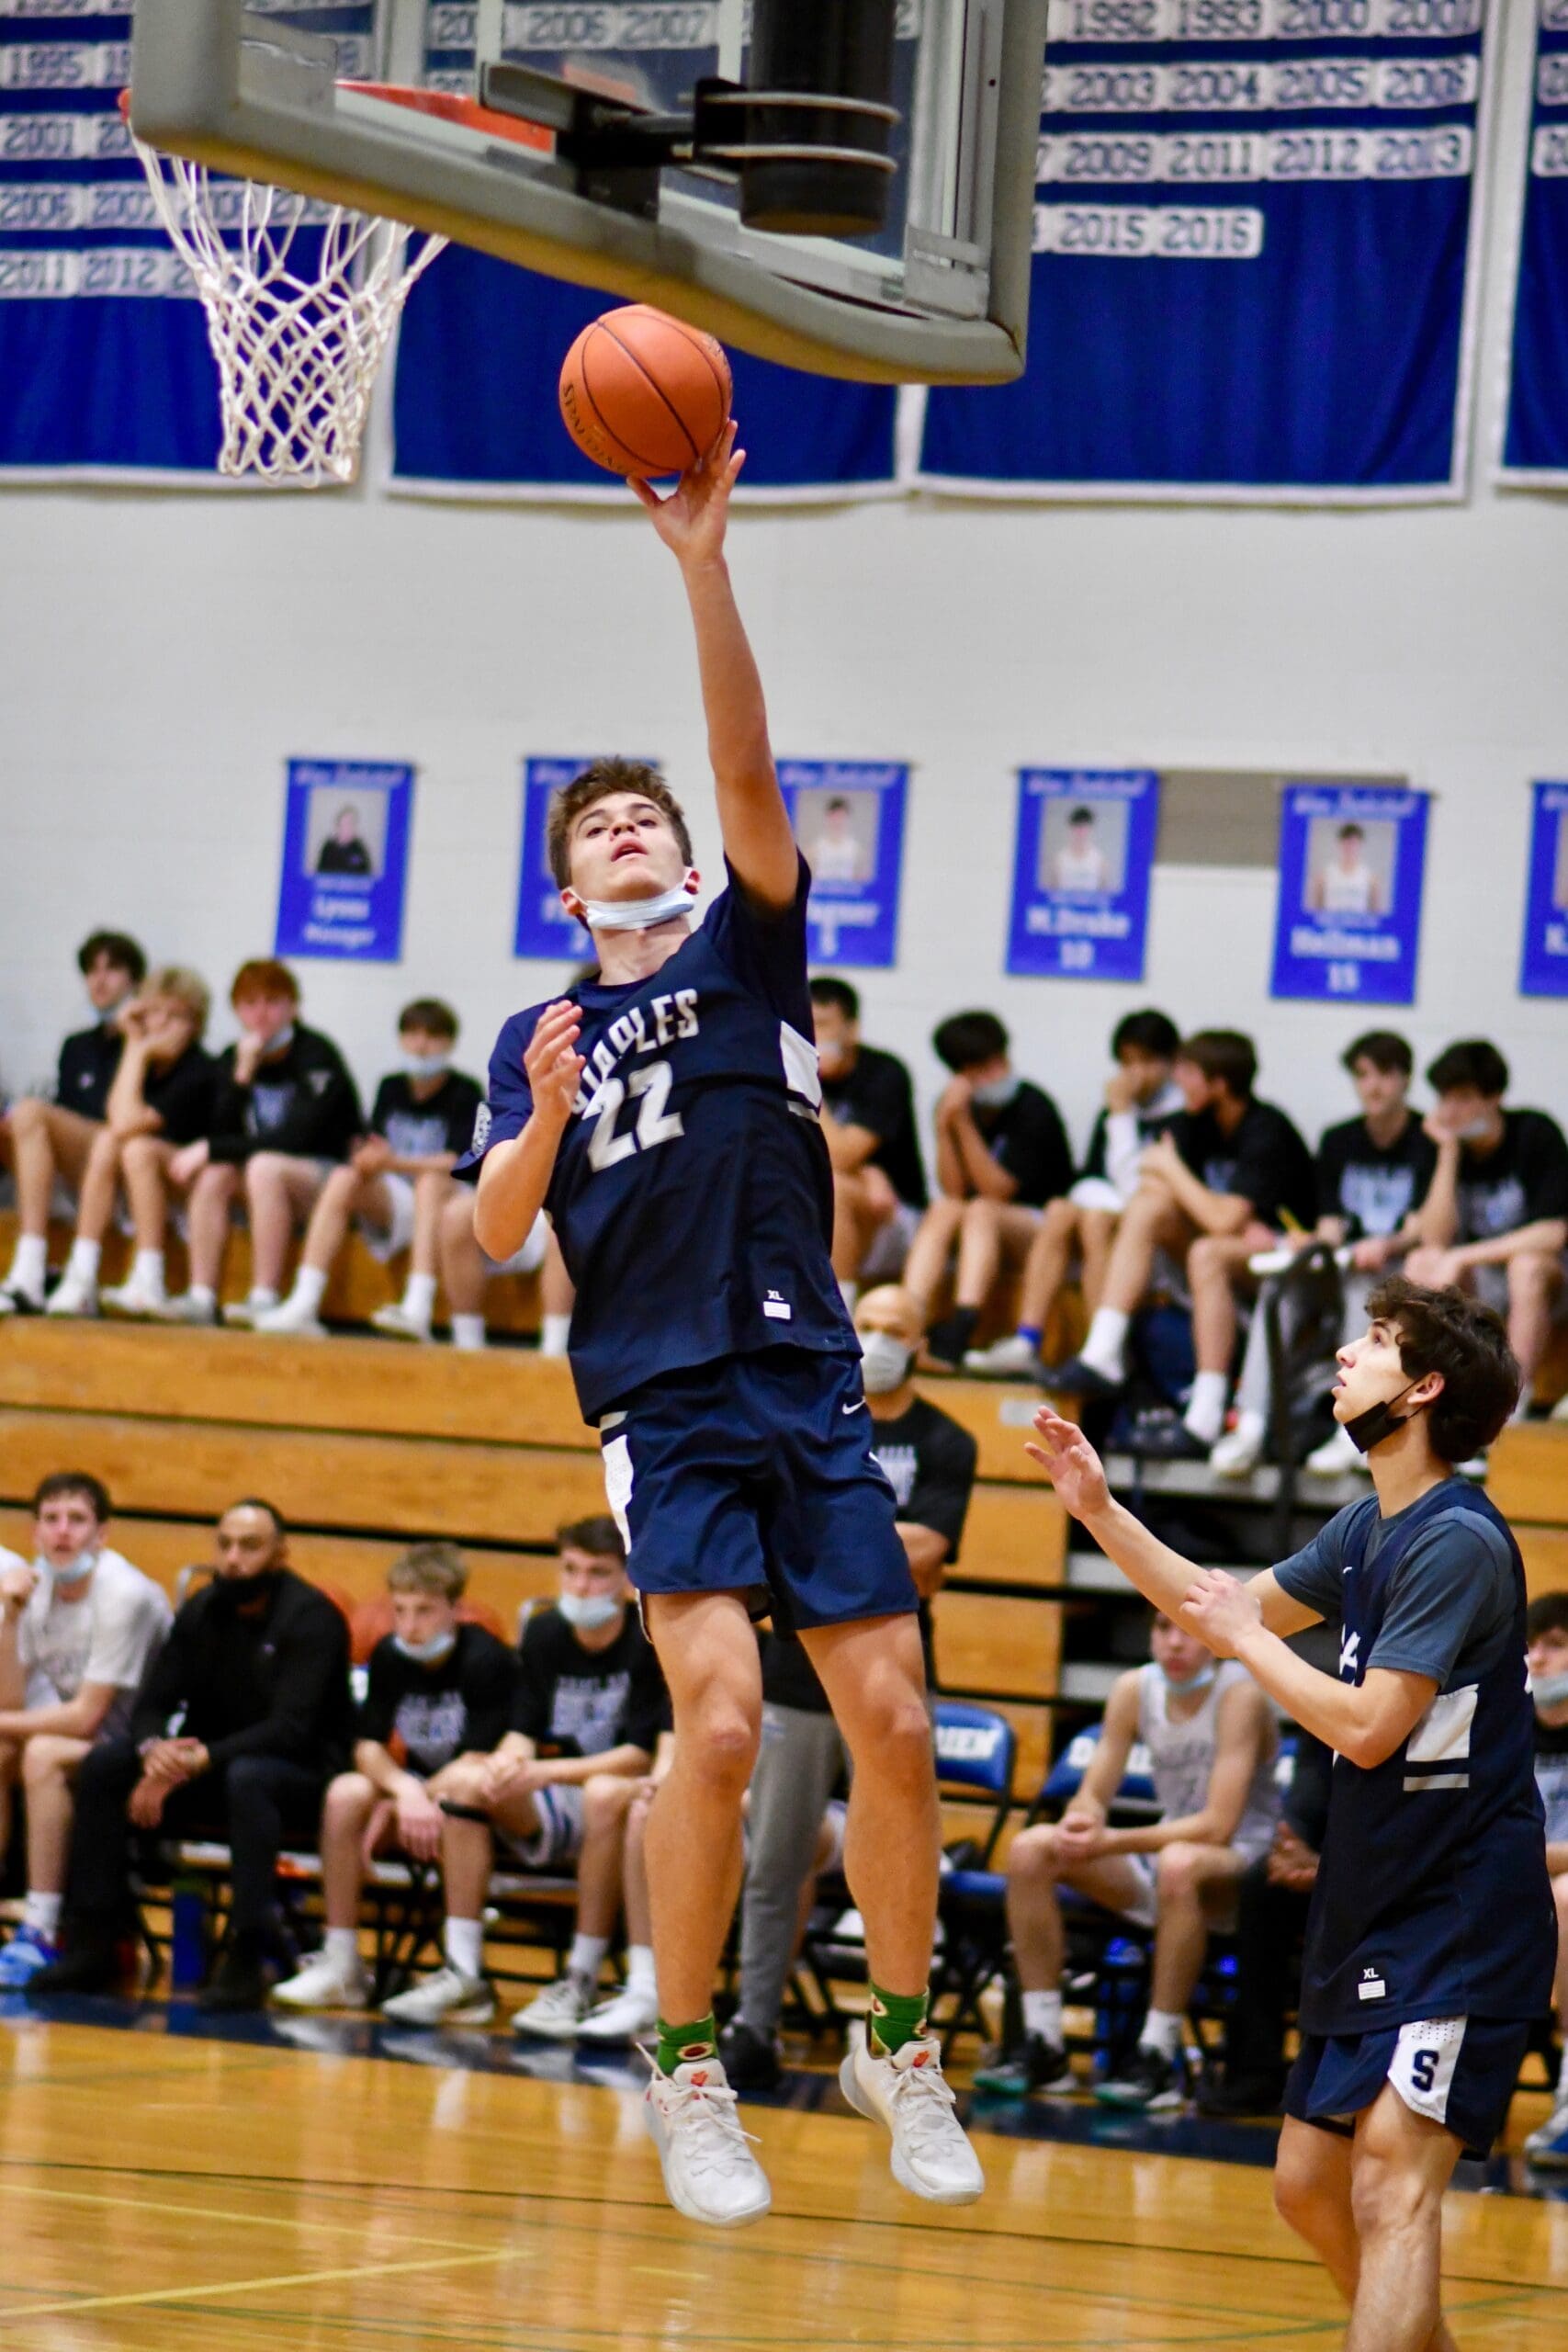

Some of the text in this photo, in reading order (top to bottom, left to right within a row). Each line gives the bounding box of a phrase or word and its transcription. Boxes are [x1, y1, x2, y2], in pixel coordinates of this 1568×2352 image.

[1070, 72, 1154, 106] 2003
[1173, 71, 1259, 104] 2004
[1278, 66, 1366, 102] 2005
[1170, 140, 1252, 175] 2011
[1273, 137, 1359, 173] 2012
[1060, 212, 1251, 251] 2015 2016
[85, 259, 157, 291] 2012
[581, 1060, 685, 1173] 22
[767, 1289, 784, 1301] XL
[1363, 1967, 1380, 1980] XL
[1412, 2049, 1440, 2092] S
